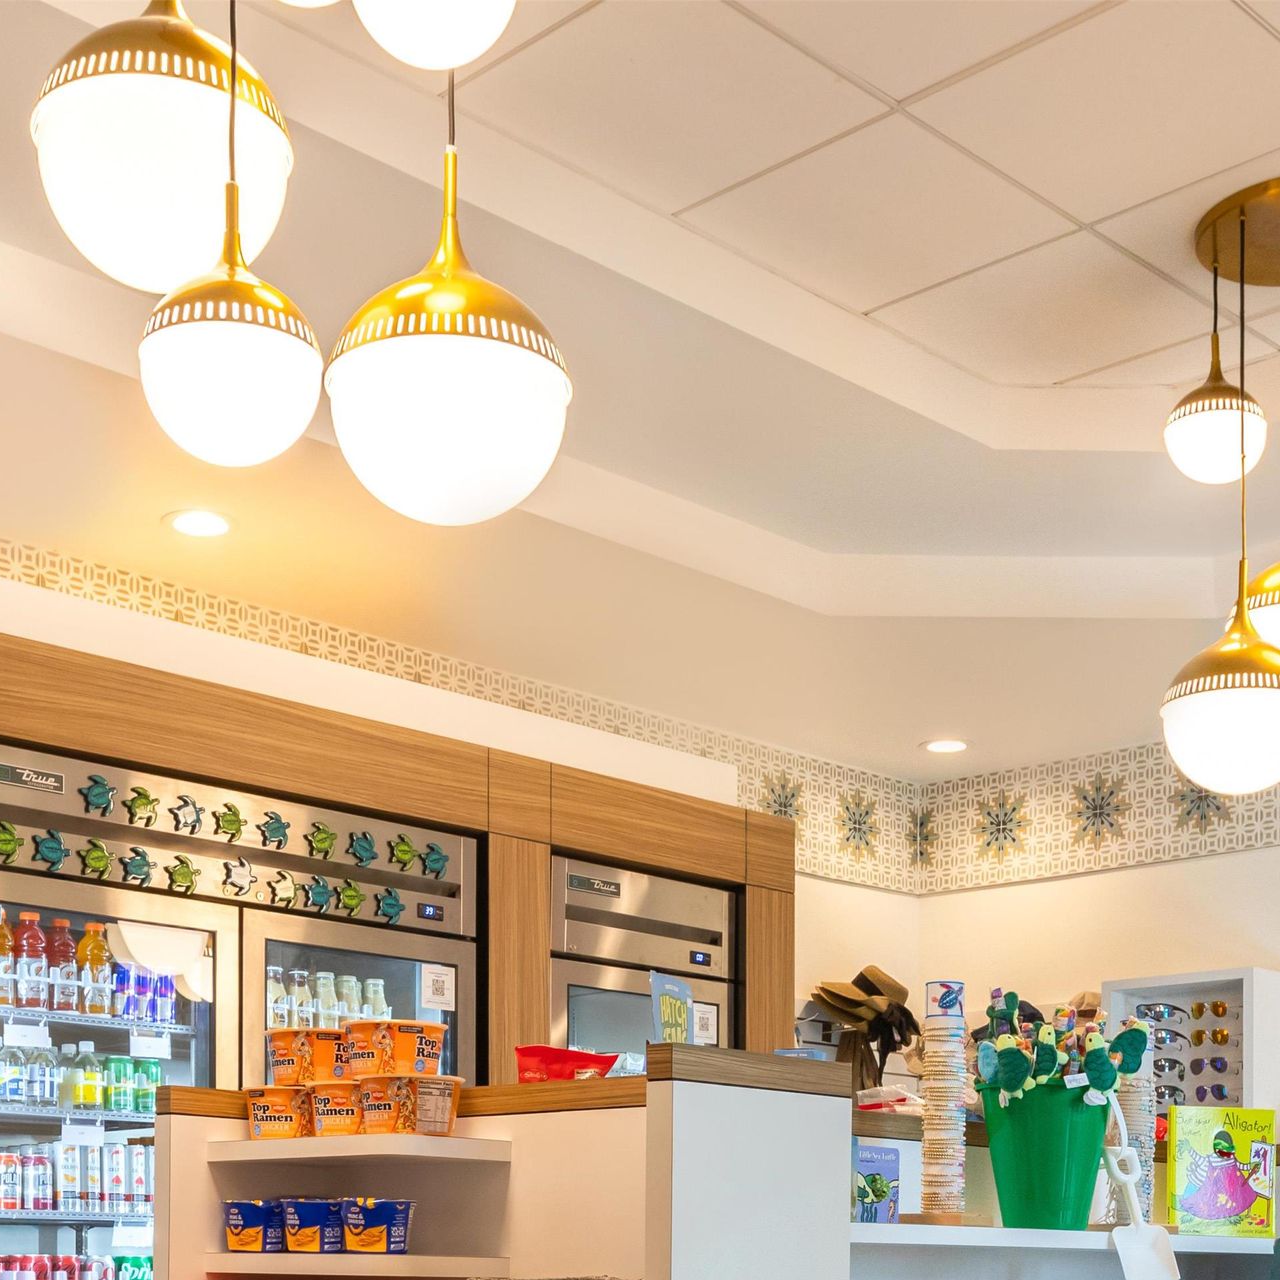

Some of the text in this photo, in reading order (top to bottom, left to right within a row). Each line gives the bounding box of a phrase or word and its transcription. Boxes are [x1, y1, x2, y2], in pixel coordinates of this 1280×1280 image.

[659, 994, 688, 1026] HATCH
[334, 1042, 348, 1053] To
[416, 1035, 437, 1050] Top
[416, 1047, 440, 1060] Ram
[312, 1095, 331, 1107] Top
[251, 1102, 270, 1115] Top
[315, 1107, 356, 1116] Ramen
[253, 1113, 294, 1122] Ramen
[1223, 1111, 1272, 1135] Alligator!
